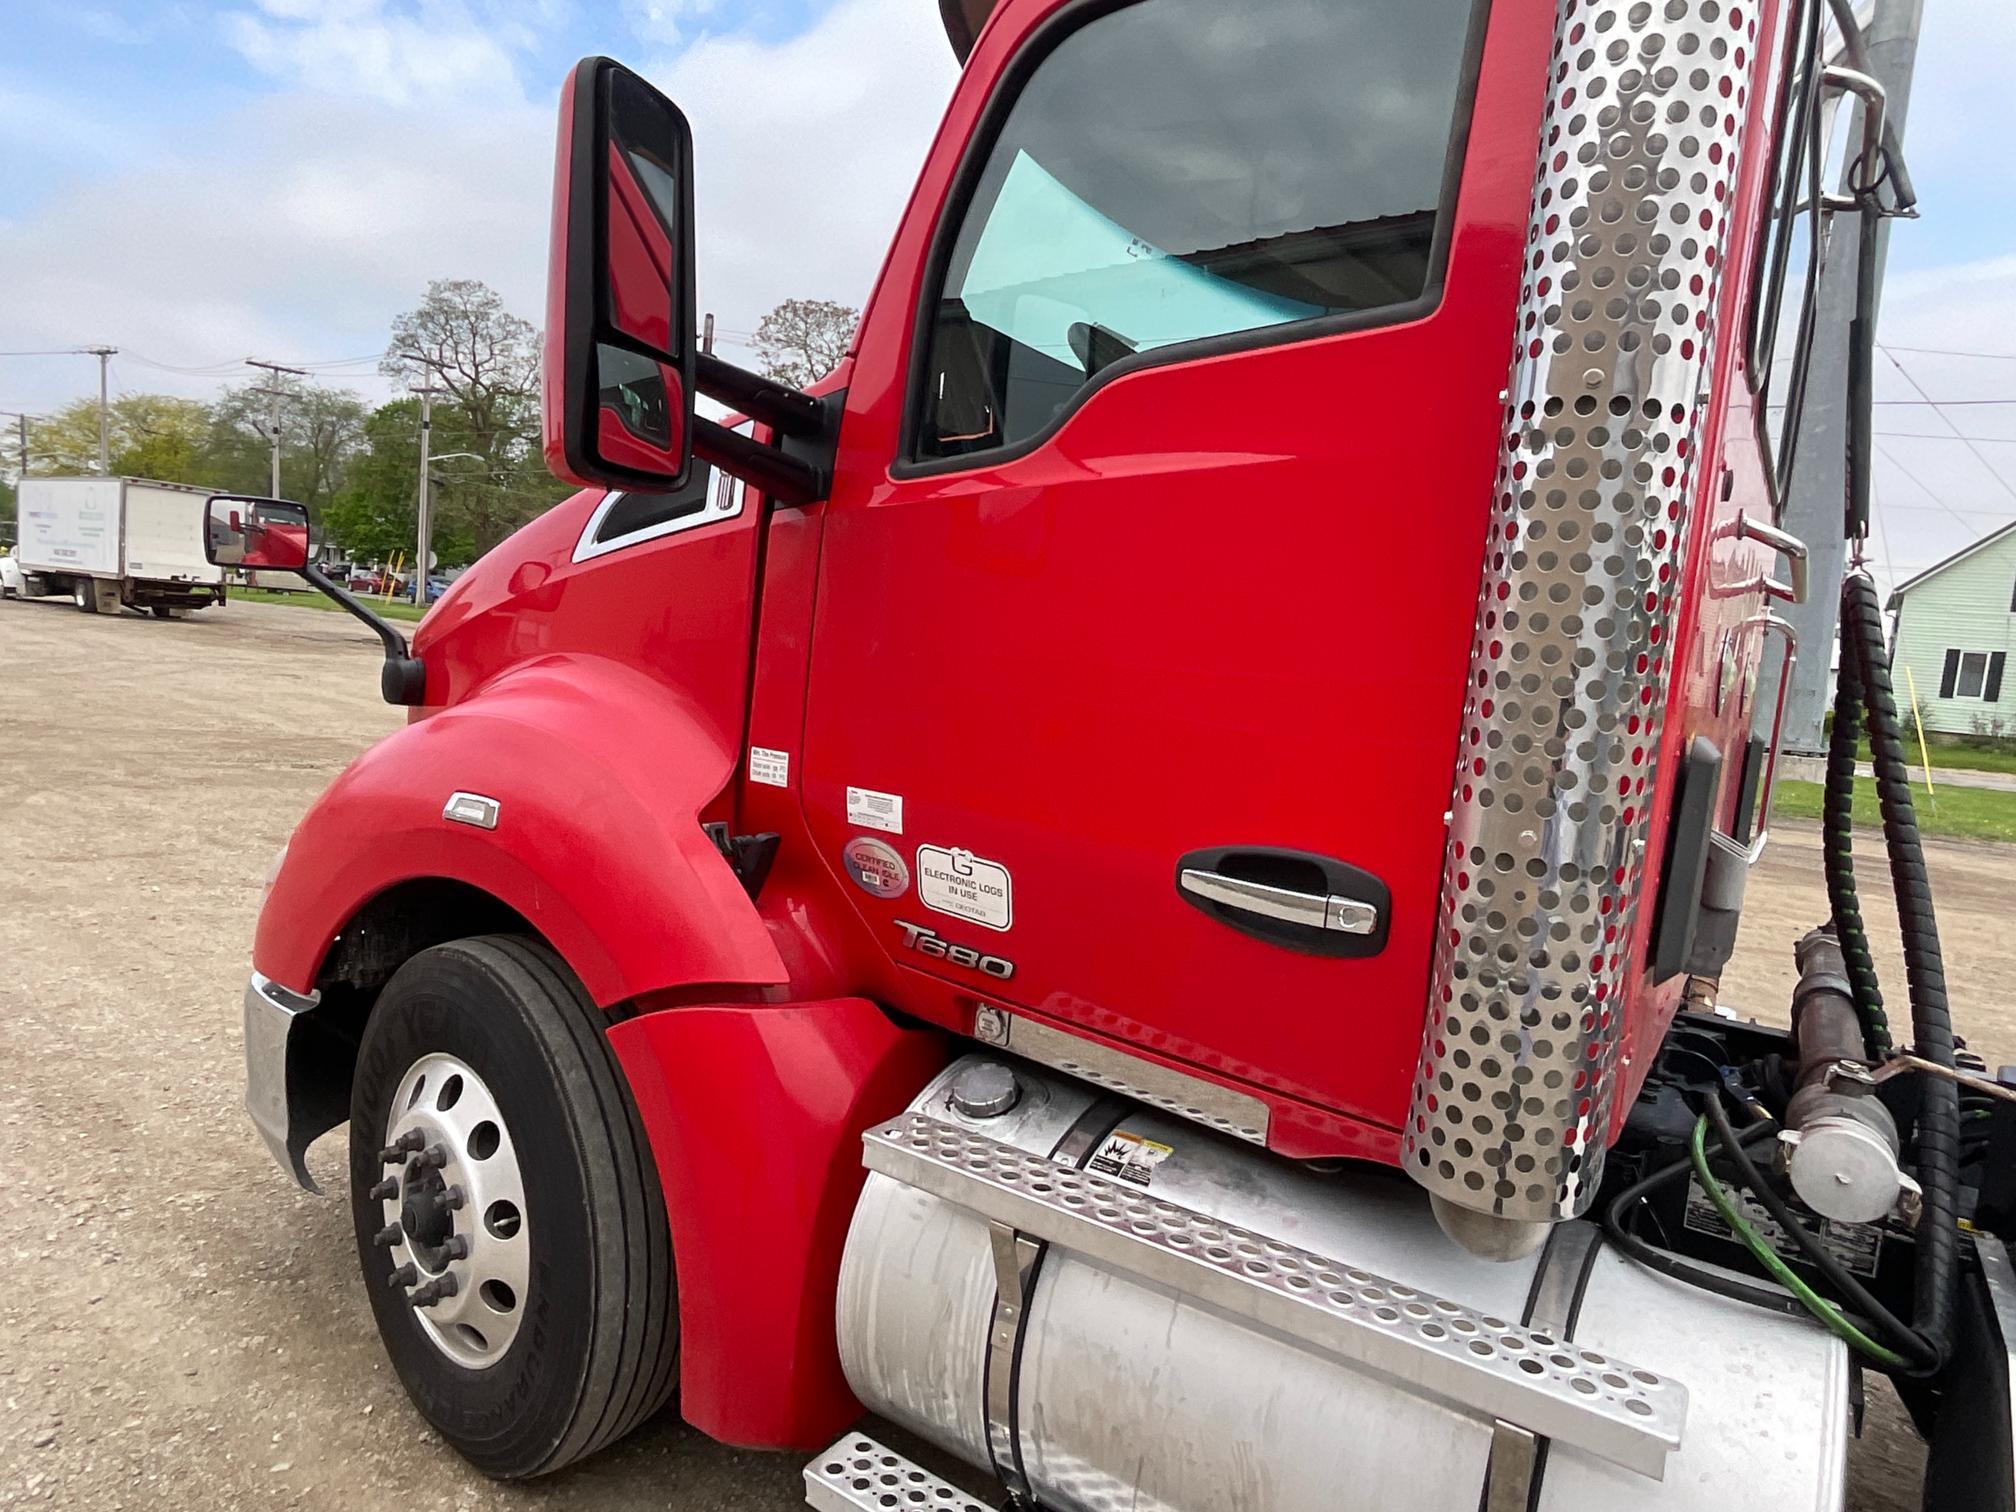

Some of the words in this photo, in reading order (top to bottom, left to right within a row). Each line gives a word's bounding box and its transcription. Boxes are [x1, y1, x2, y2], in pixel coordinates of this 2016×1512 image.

[853, 861, 880, 875] CLEAN
[855, 853, 896, 870] CERTIFIED
[924, 867, 977, 890] ELECTRONIC
[979, 883, 1004, 898] LOGS
[948, 885, 958, 896] IN
[960, 889, 978, 901] USE
[893, 919, 1014, 979] T680
